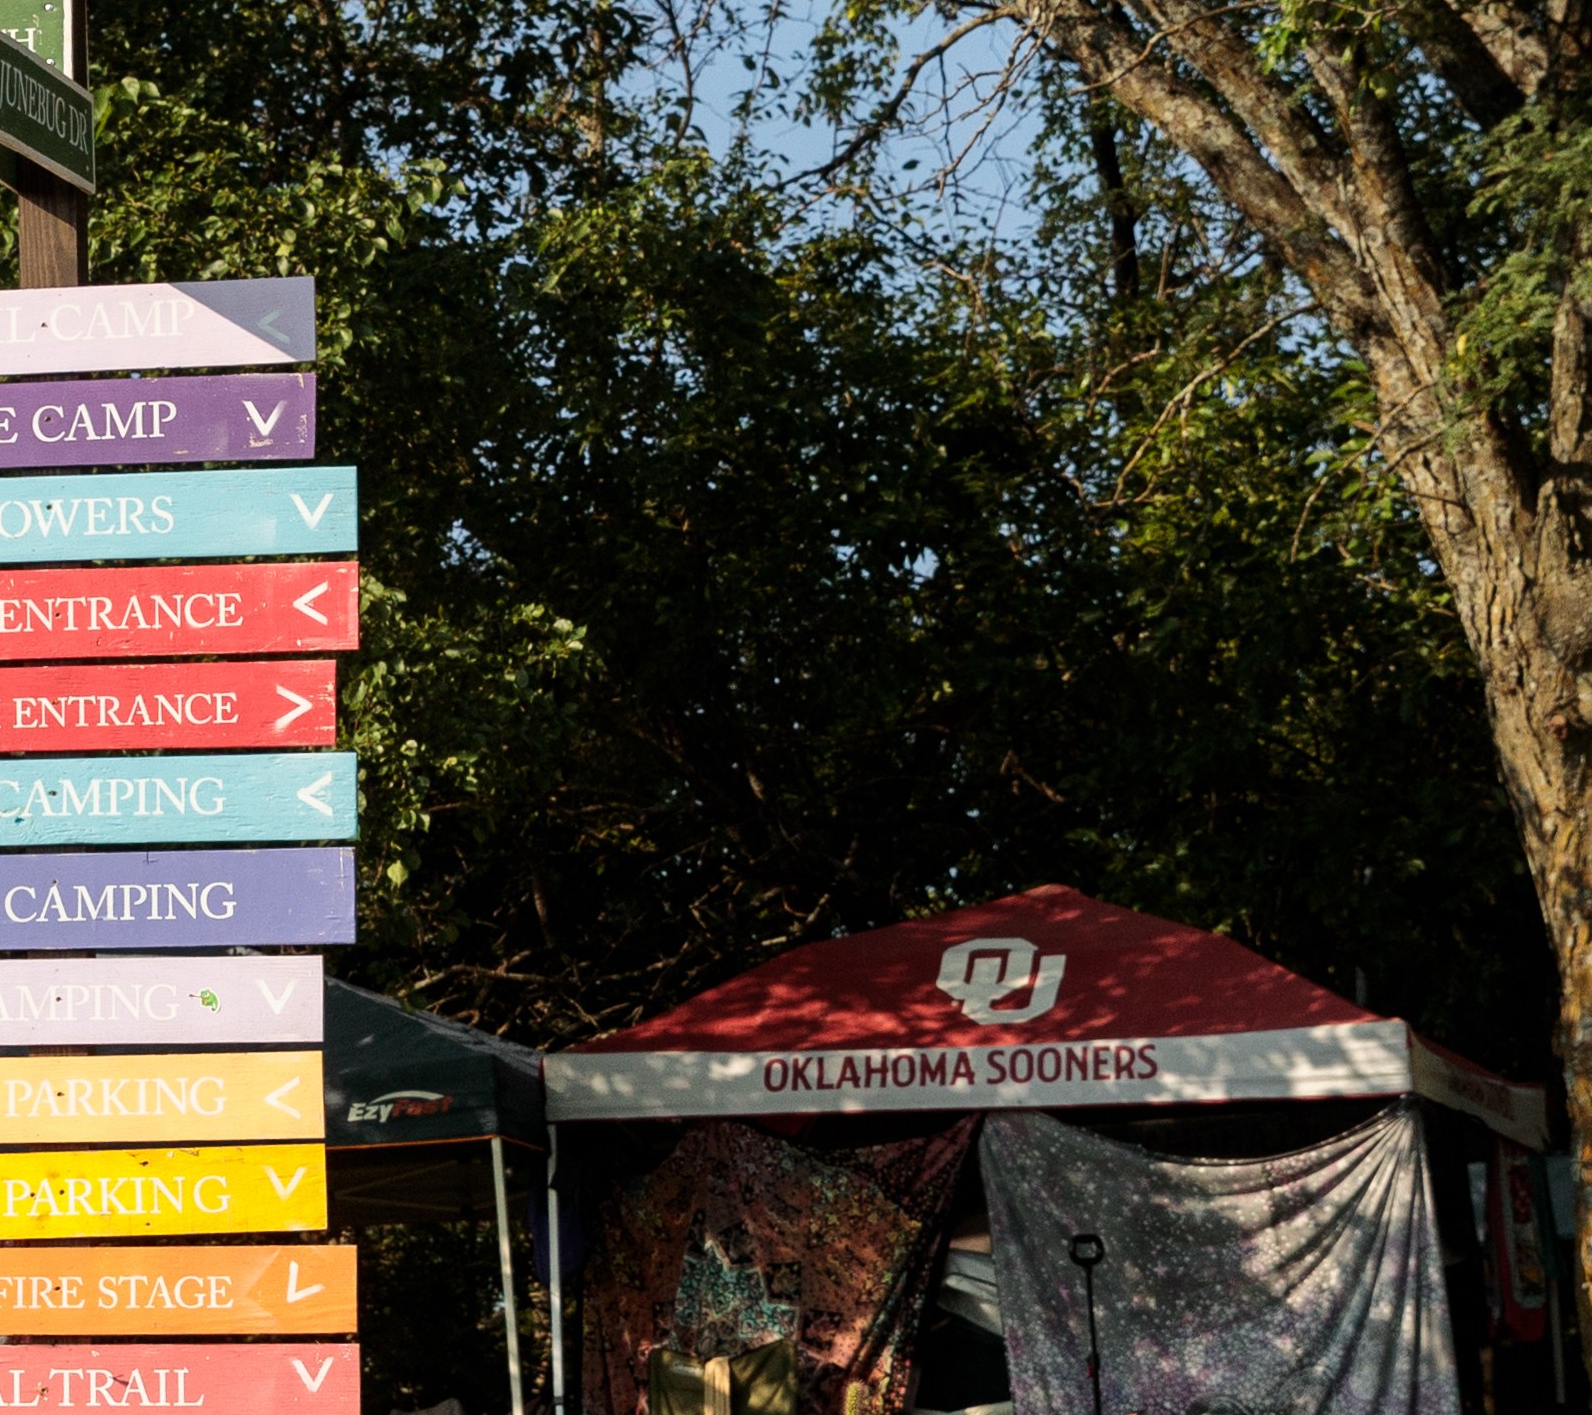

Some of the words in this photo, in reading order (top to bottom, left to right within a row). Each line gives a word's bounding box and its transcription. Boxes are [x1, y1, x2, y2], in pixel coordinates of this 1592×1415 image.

[68, 104, 90, 155] DR
[48, 299, 197, 344] CAMP
[31, 400, 178, 443] CAMP
[13, 692, 240, 729] ENTRANCE
[4, 882, 237, 924] CAMPING
[763, 1051, 975, 1092] OKLAHOMA
[986, 1044, 1158, 1084] SOONERS
[3, 1076, 228, 1117] PARKING
[347, 1096, 453, 1123] EzyFast
[3, 1175, 231, 1217] PARKING
[97, 1275, 234, 1309] STAGE
[48, 1367, 205, 1408] TRAIL
